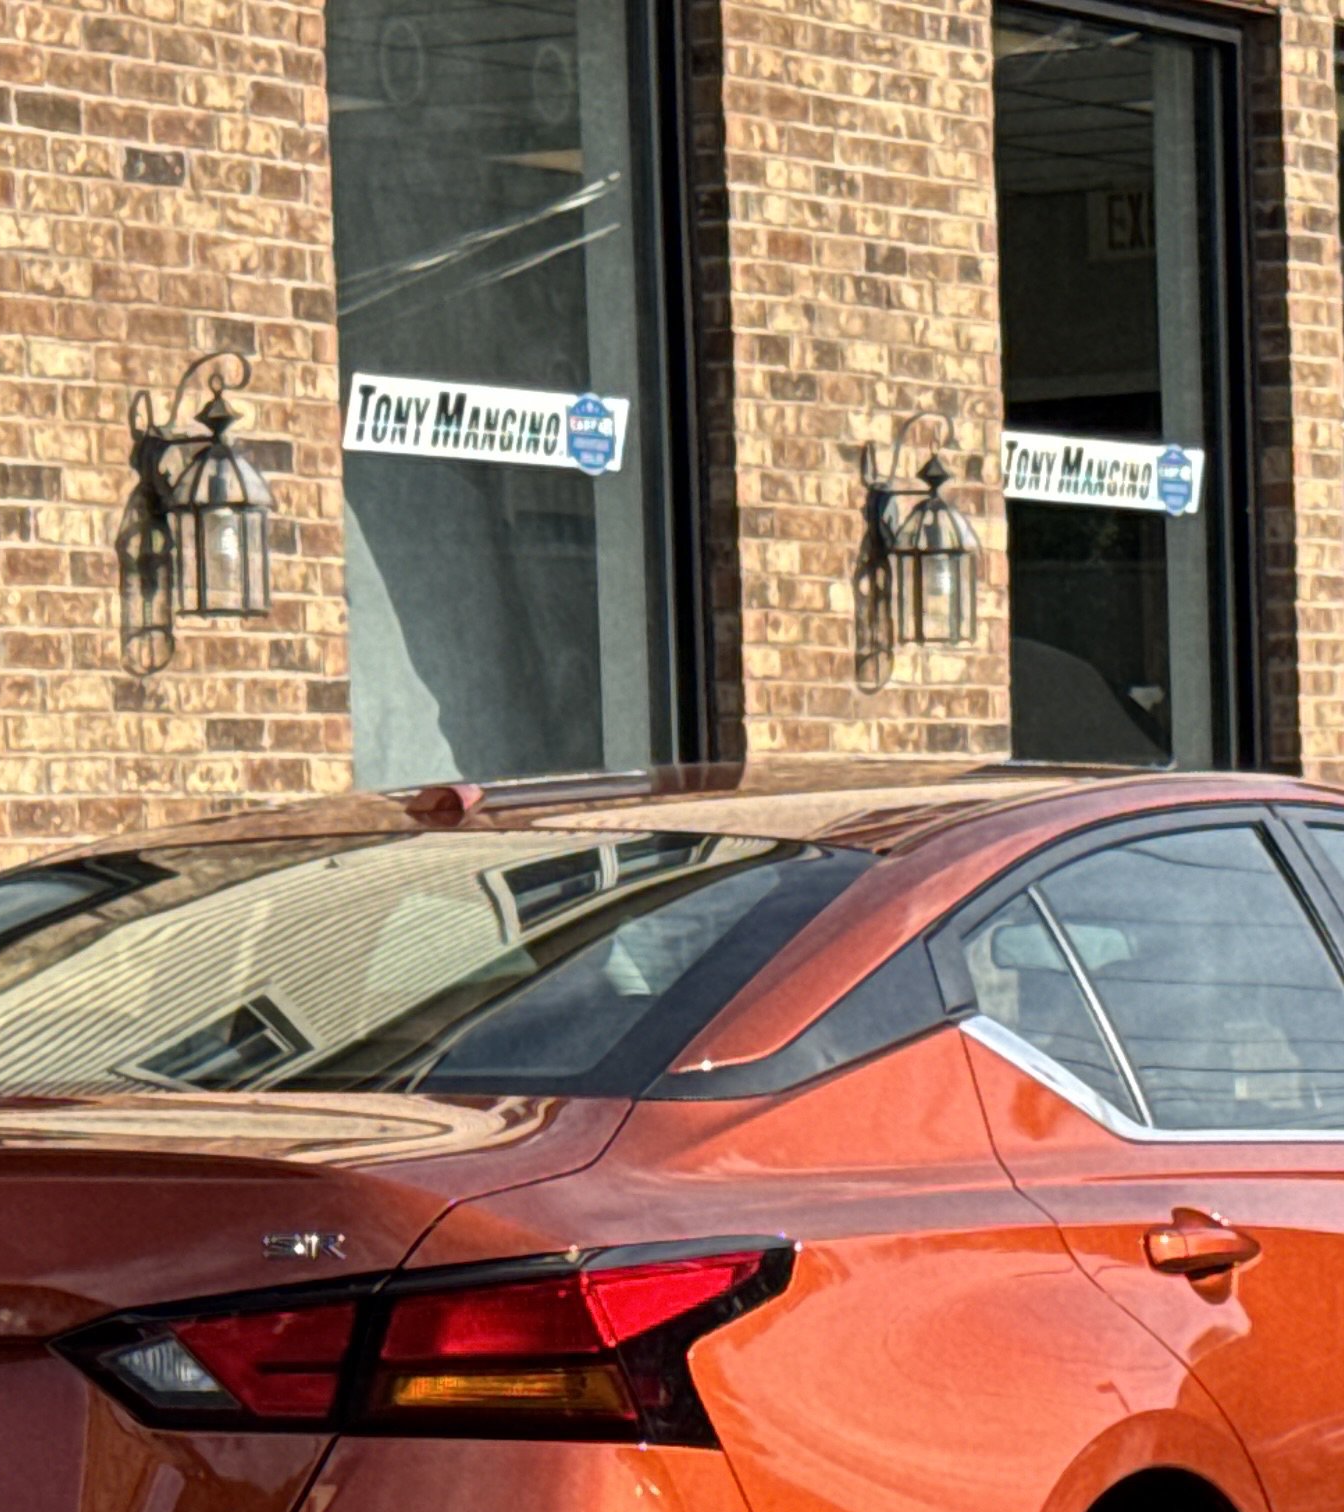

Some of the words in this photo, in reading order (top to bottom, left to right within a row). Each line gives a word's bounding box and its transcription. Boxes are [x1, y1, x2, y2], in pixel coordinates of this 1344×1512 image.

[355, 384, 430, 445] TONY
[431, 391, 561, 457] MANGINO
[1003, 439, 1057, 493] TONY
